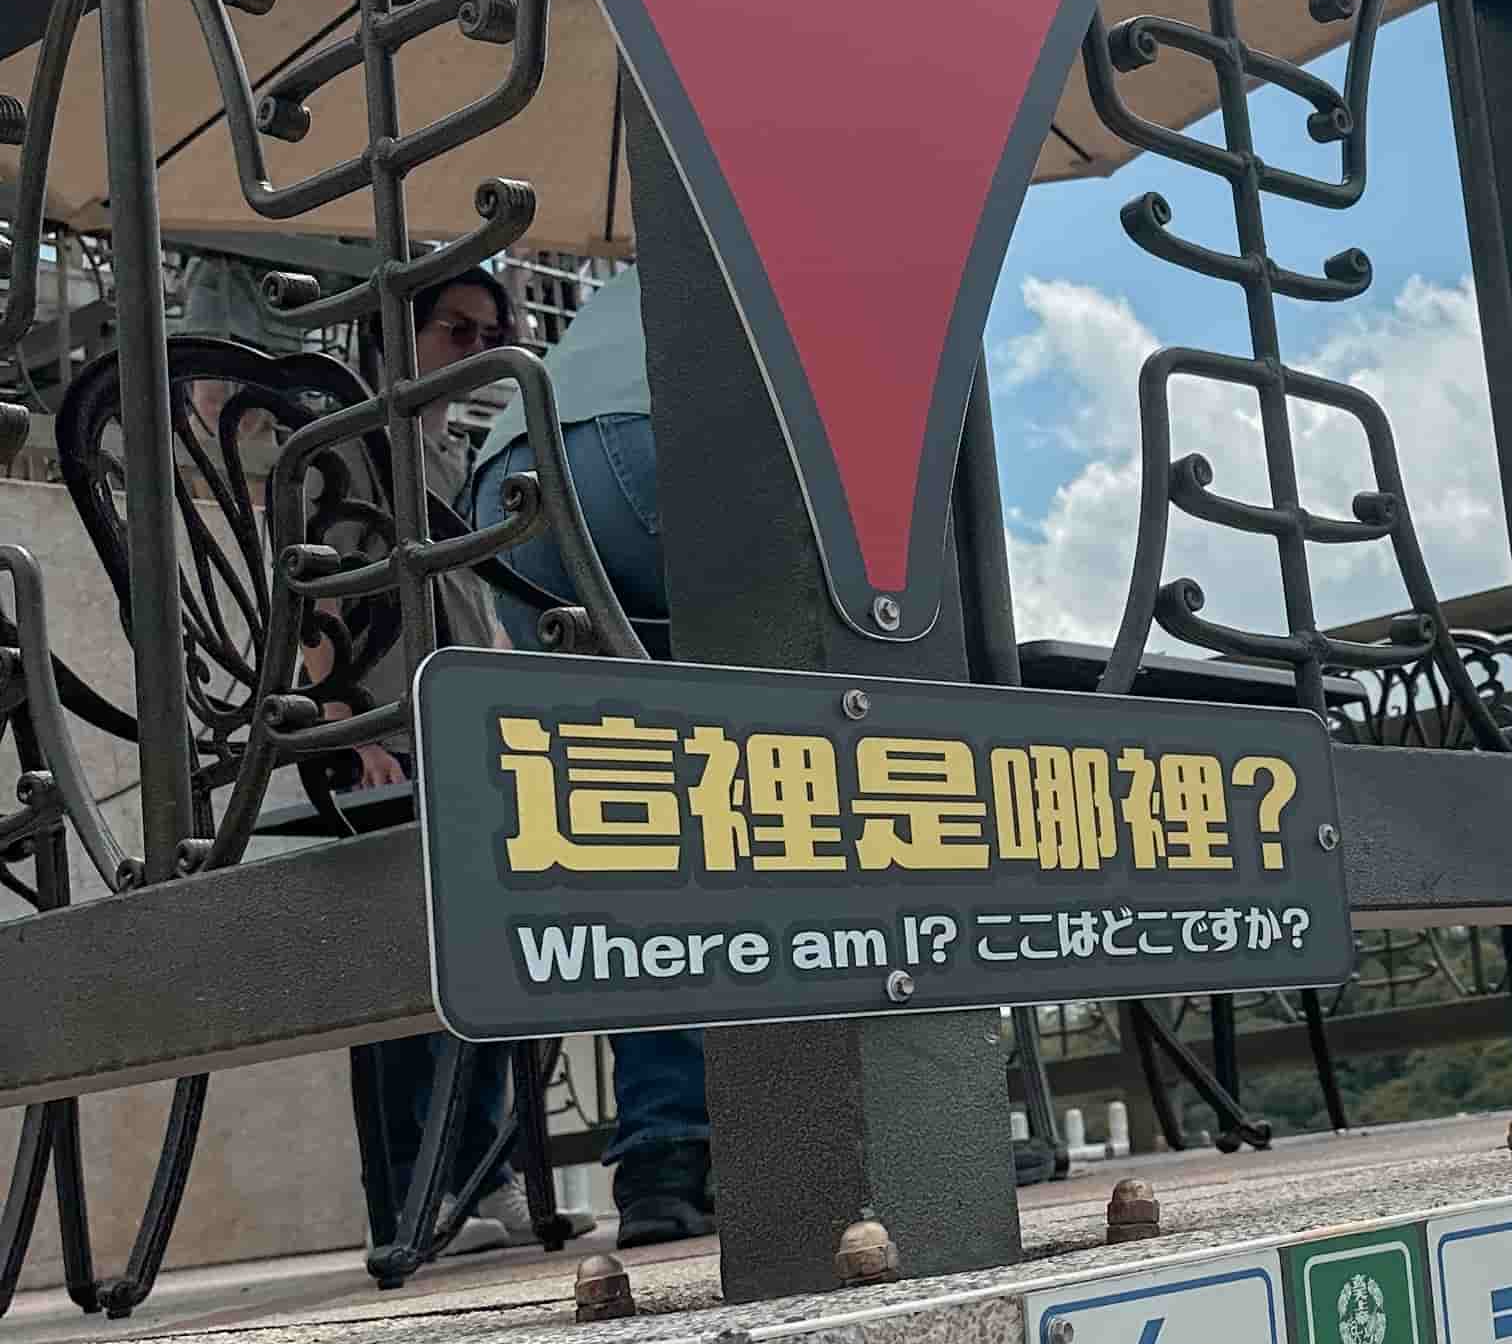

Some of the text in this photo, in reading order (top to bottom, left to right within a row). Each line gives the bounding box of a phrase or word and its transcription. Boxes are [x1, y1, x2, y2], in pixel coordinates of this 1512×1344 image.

[498, 715, 1298, 873] 這裡是哪裡?
[516, 923, 771, 984] Where
[791, 927, 888, 970] am
[976, 905, 1311, 963] ここはどこですか?
